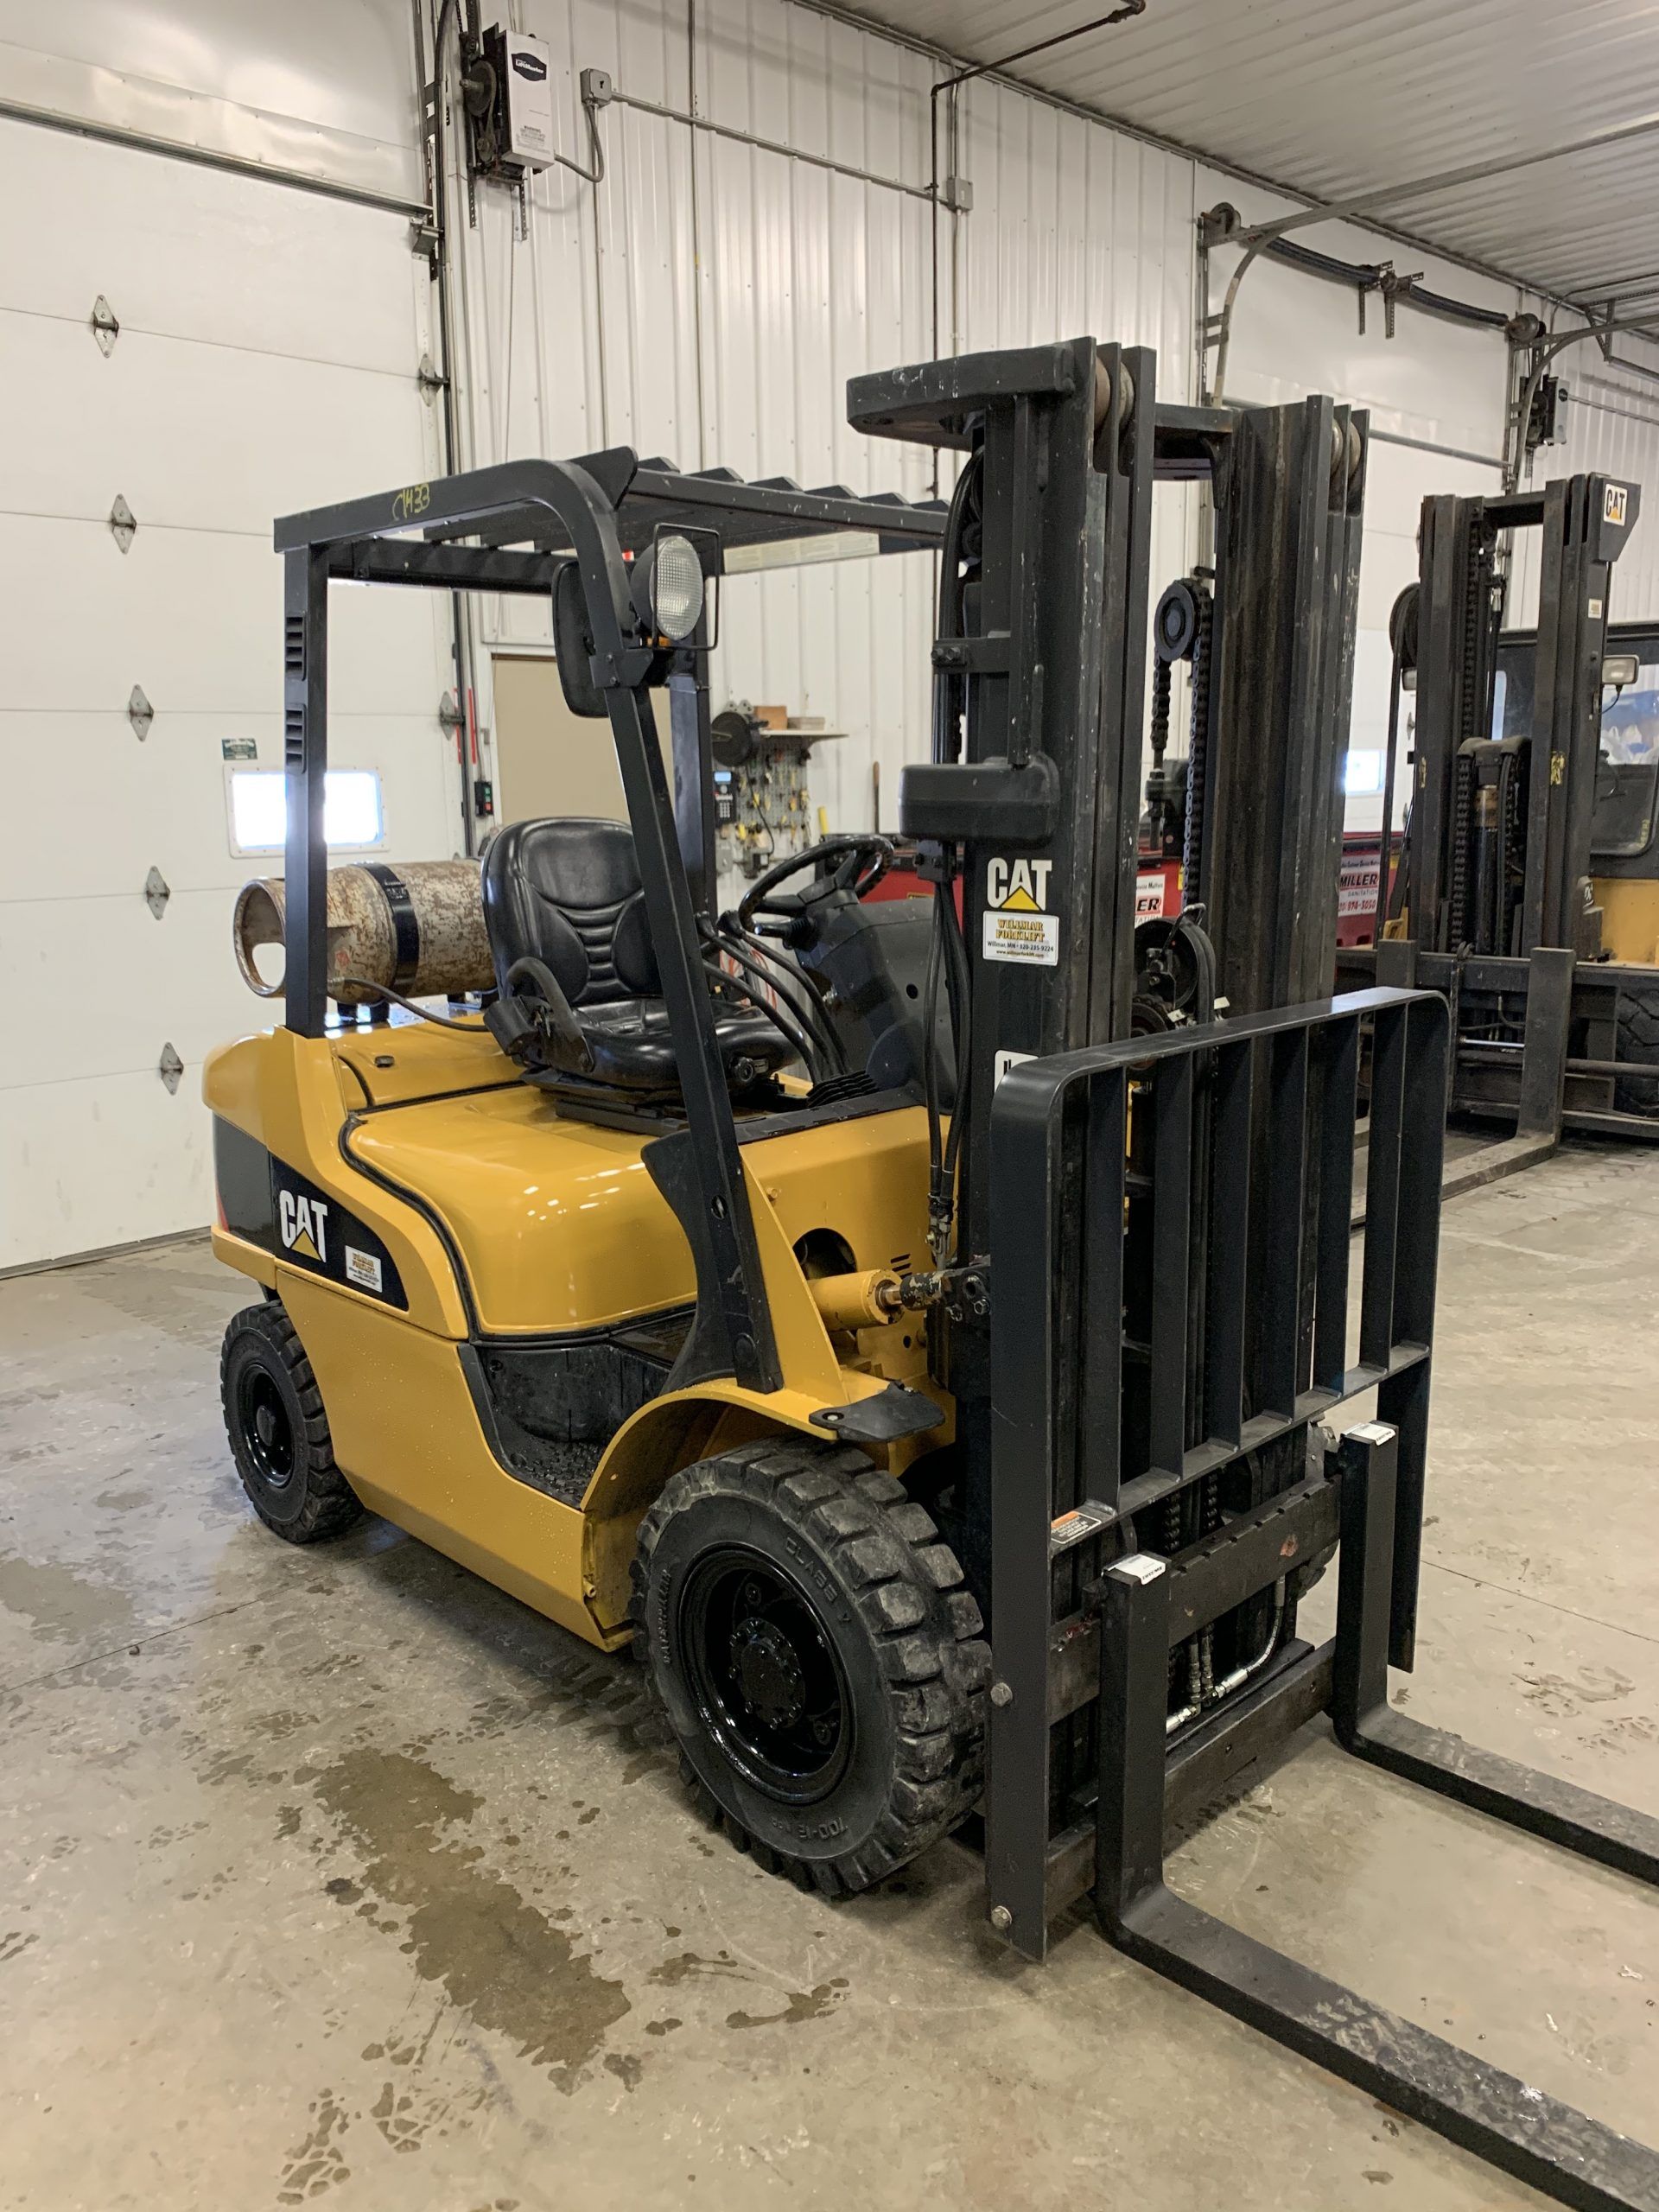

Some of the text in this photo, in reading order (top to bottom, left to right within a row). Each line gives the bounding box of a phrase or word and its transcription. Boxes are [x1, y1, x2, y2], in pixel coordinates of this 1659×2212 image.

[1605, 489, 1625, 520] CAT
[987, 857, 1052, 912] CAT
[1340, 874, 1377, 887] MILLER
[995, 929, 1045, 942] FORKLIFT
[997, 918, 1044, 931] WILLMAR
[278, 1189, 328, 1263] CAT
